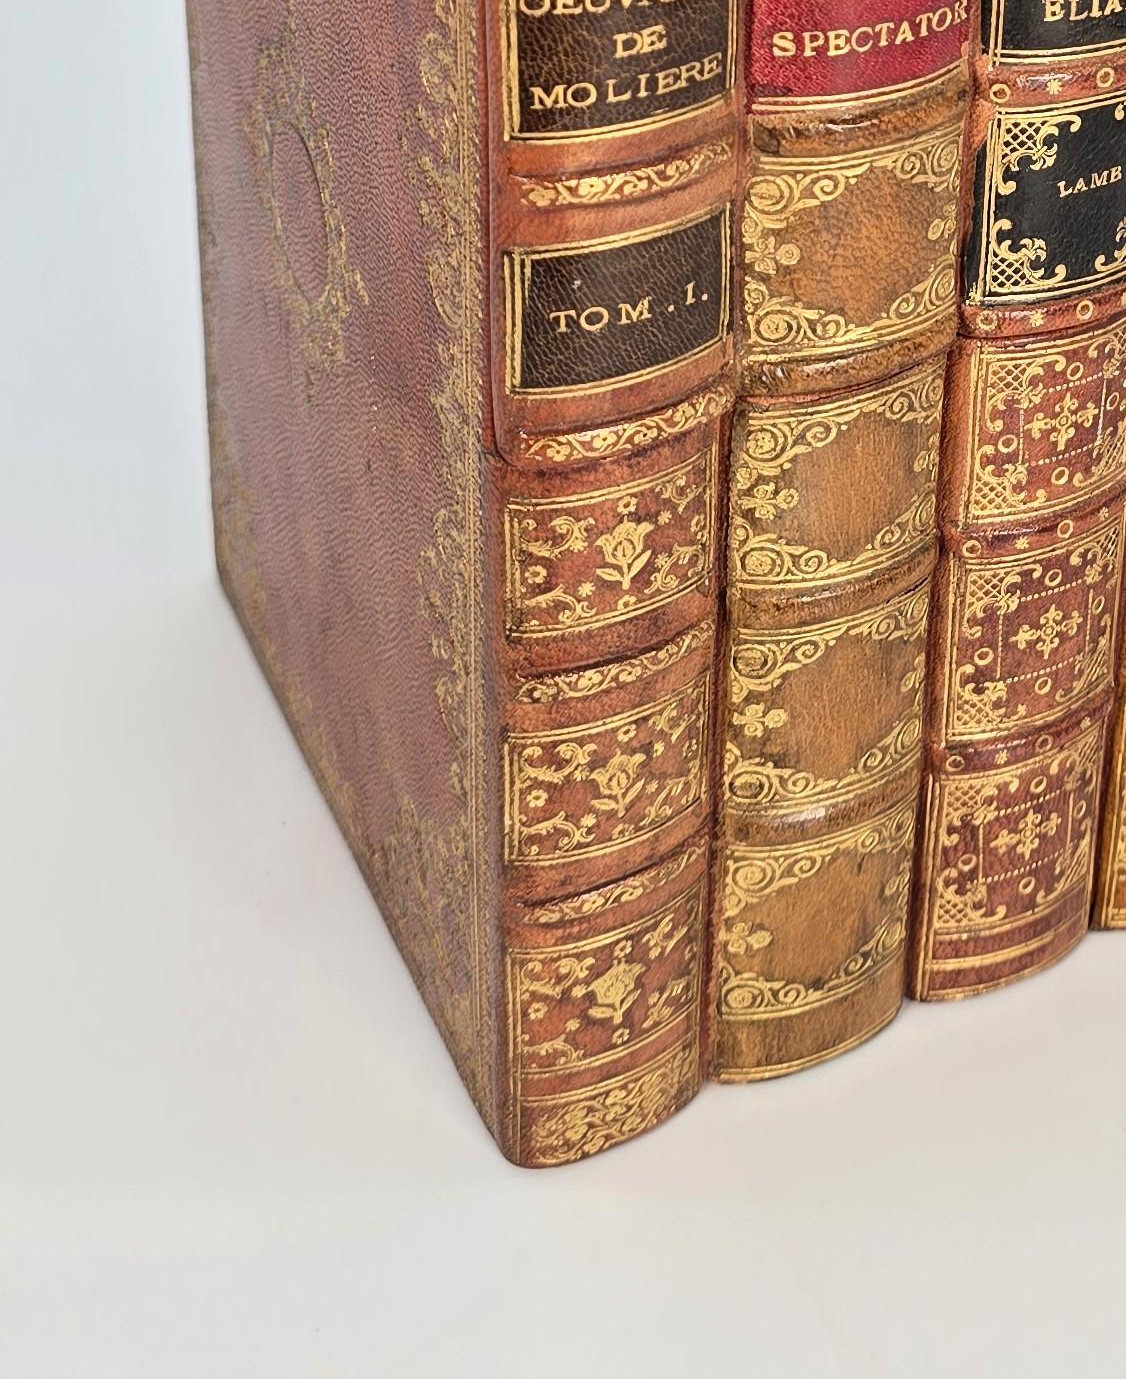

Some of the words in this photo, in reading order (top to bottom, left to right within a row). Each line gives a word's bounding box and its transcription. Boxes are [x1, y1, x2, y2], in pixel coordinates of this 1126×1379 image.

[612, 24, 668, 59] DE
[529, 51, 723, 111] MOLIERE
[1057, 165, 1122, 198] LAMB
